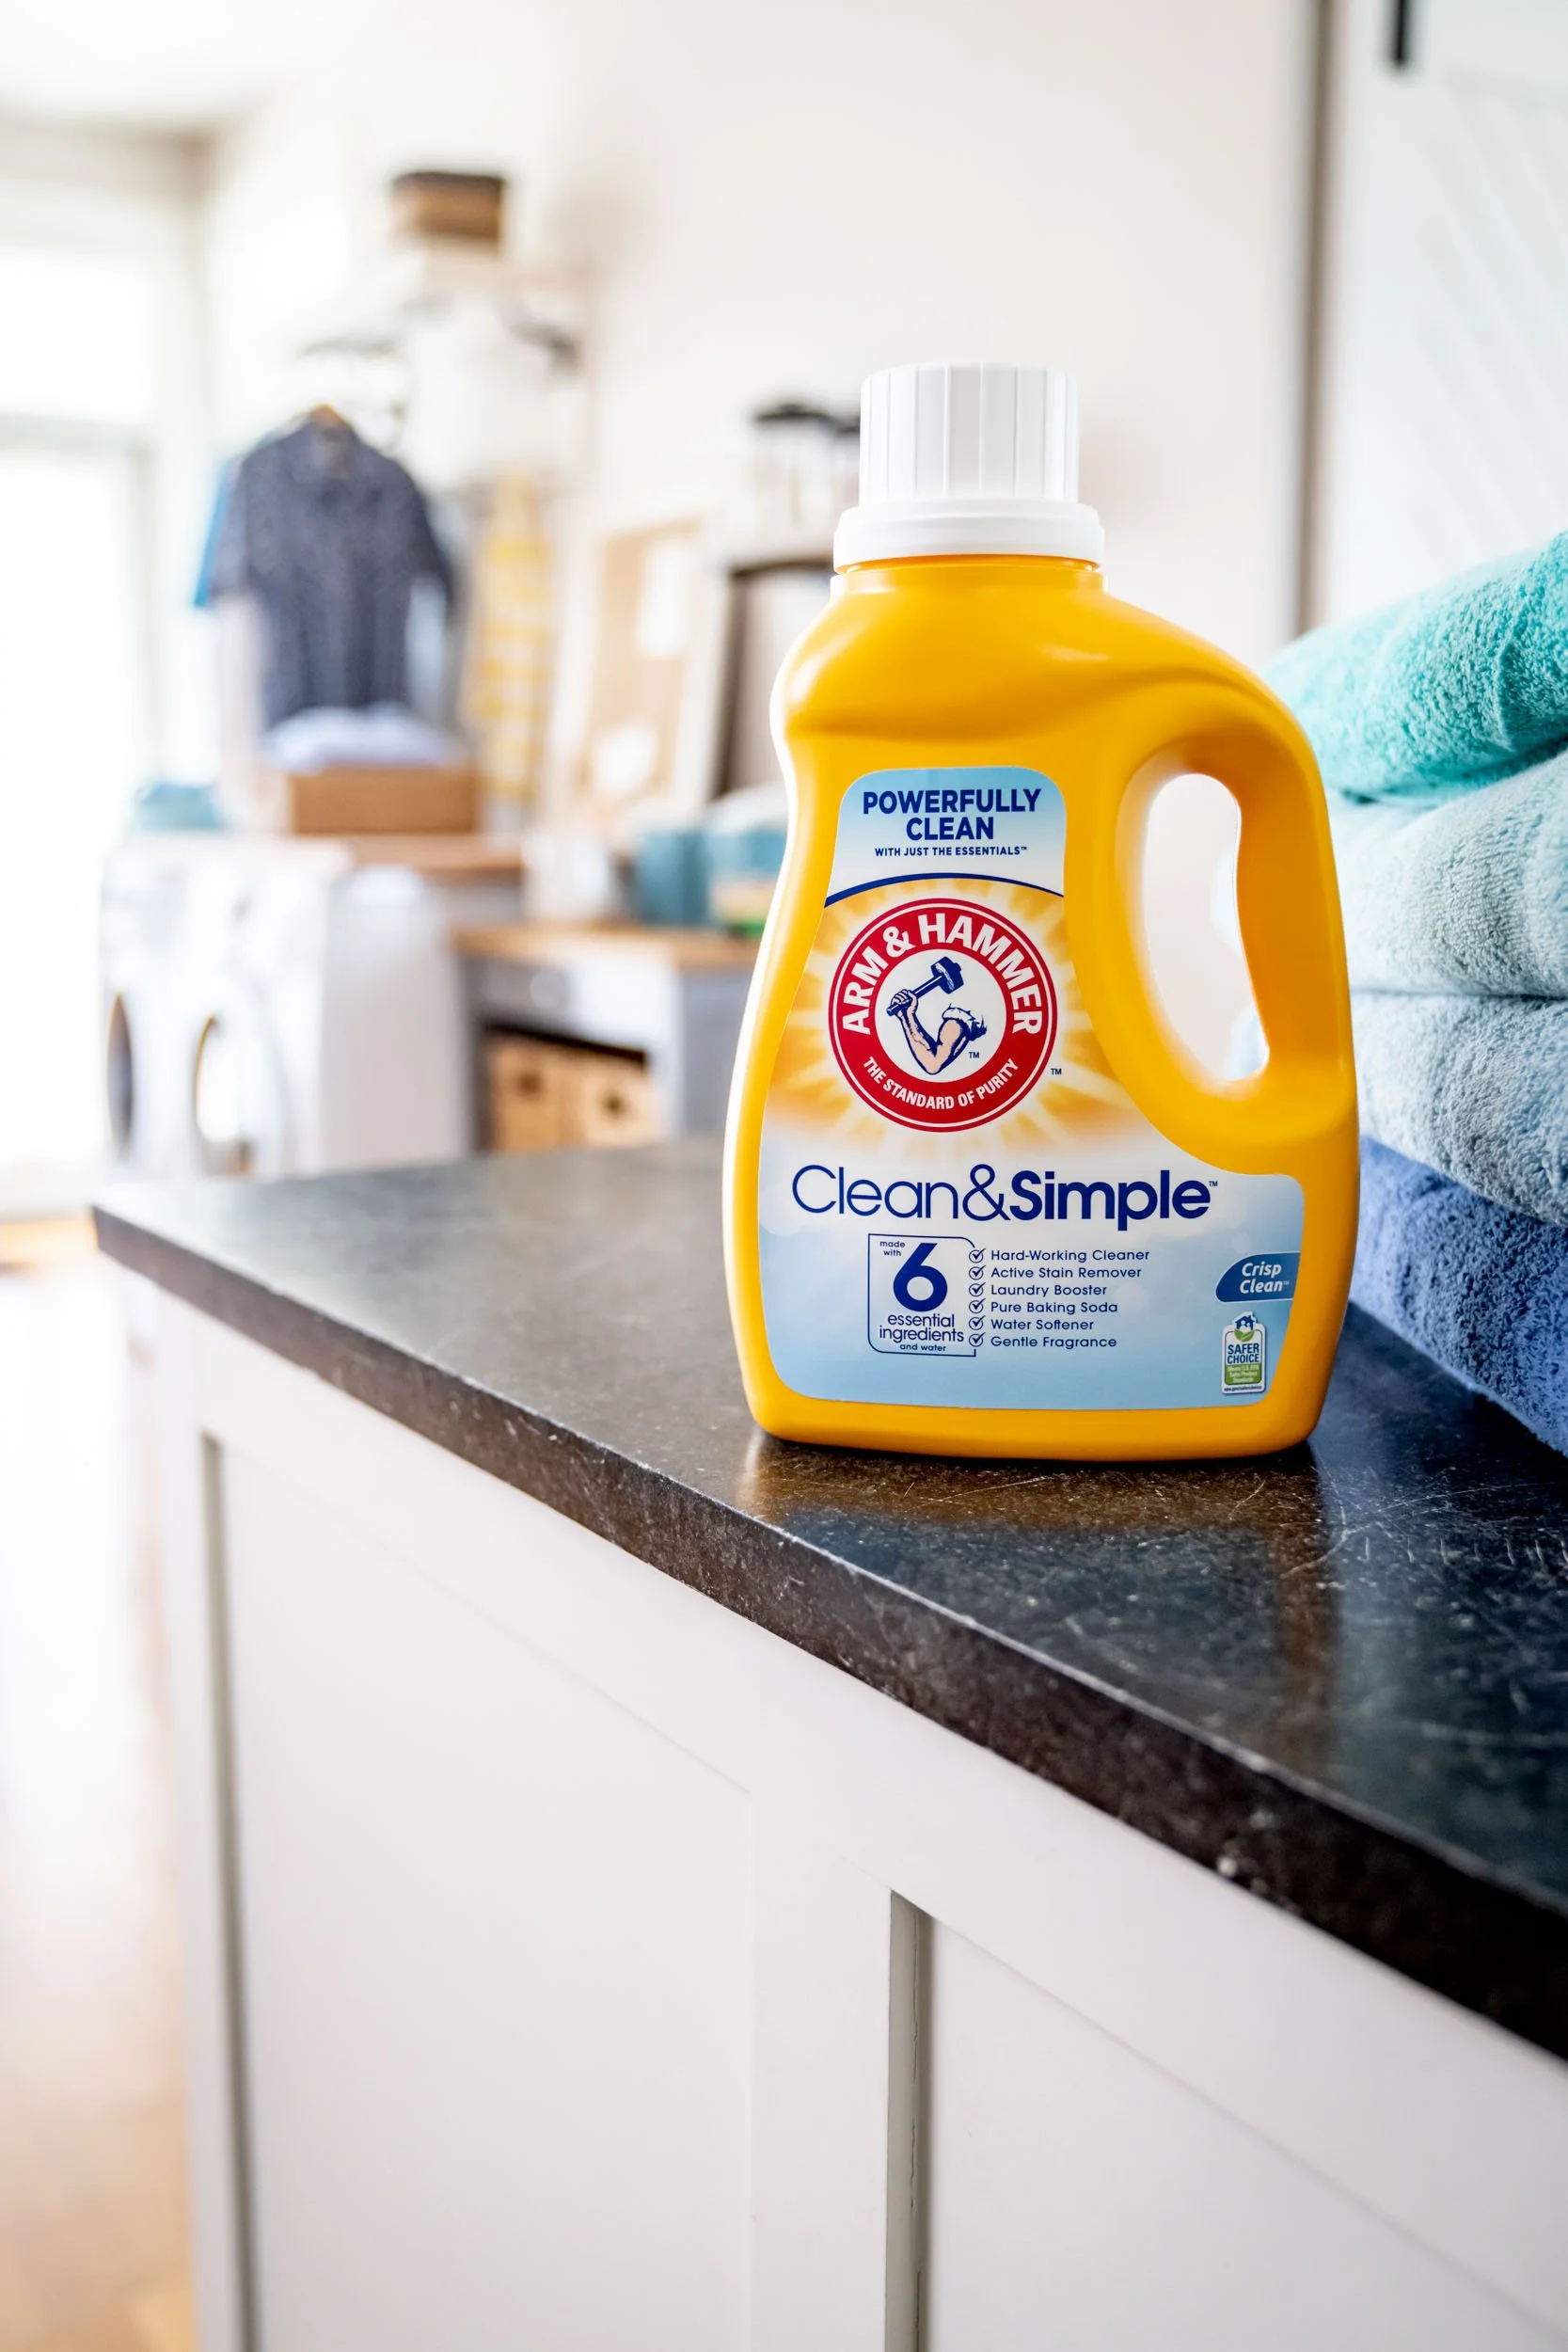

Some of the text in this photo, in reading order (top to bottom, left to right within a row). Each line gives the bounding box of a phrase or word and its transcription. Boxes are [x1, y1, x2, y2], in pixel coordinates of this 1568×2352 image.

[863, 788, 1042, 815] POWERFULLY
[906, 816, 994, 841] CLEAN
[874, 847, 901, 857] WITH
[903, 847, 930, 857] JUST
[931, 847, 953, 856] THE
[842, 913, 1044, 1036] ARM & HAMMER
[863, 1056, 1020, 1110] THE STANDARD OF PURITY
[879, 1240, 906, 1248] made
[990, 1249, 1150, 1263] Hard-Working Cleaner
[893, 1242, 948, 1312] 6
[990, 1266, 1142, 1279] Active Stain Remover
[1242, 1261, 1282, 1279] Crisp
[990, 1284, 1107, 1297] Laundry Booster
[990, 1301, 1118, 1315] Pure Baking Soda
[887, 1313, 955, 1328] essential
[990, 1319, 1095, 1330] Water Softener
[879, 1325, 965, 1343] ingredients
[990, 1336, 1117, 1350] Gentle Fragrance
[1227, 1343, 1259, 1355] SAFER
[1227, 1353, 1259, 1364] CHOICE
